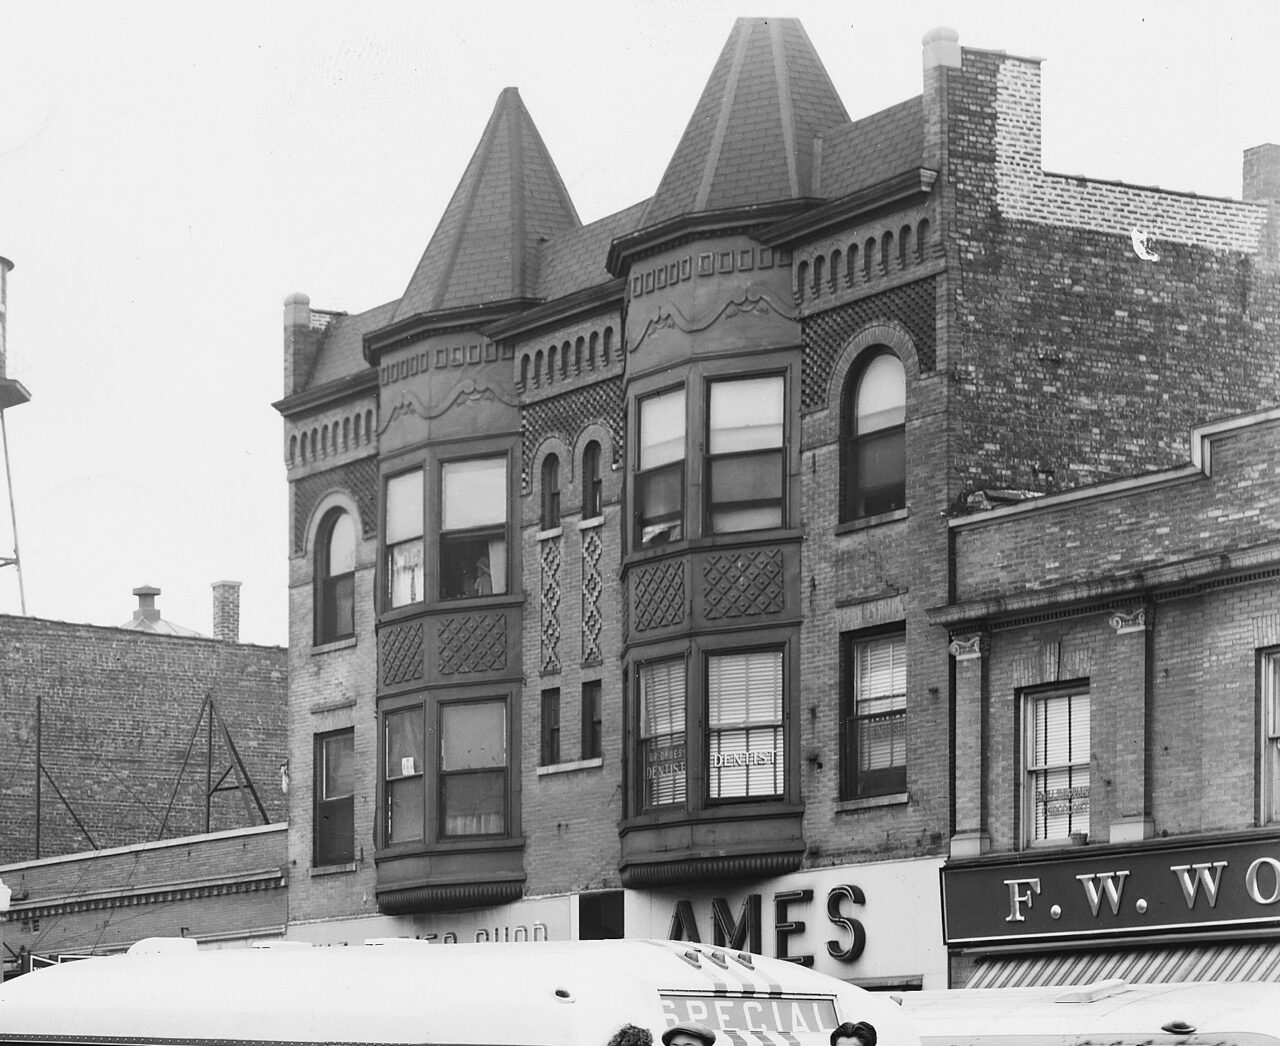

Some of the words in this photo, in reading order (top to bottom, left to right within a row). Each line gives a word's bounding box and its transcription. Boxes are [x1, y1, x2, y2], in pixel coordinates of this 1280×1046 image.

[647, 761, 685, 779] DENTIST
[714, 750, 777, 768] DENTIST
[666, 884, 866, 967] AMES
[661, 1000, 839, 1032] SPECIAL
